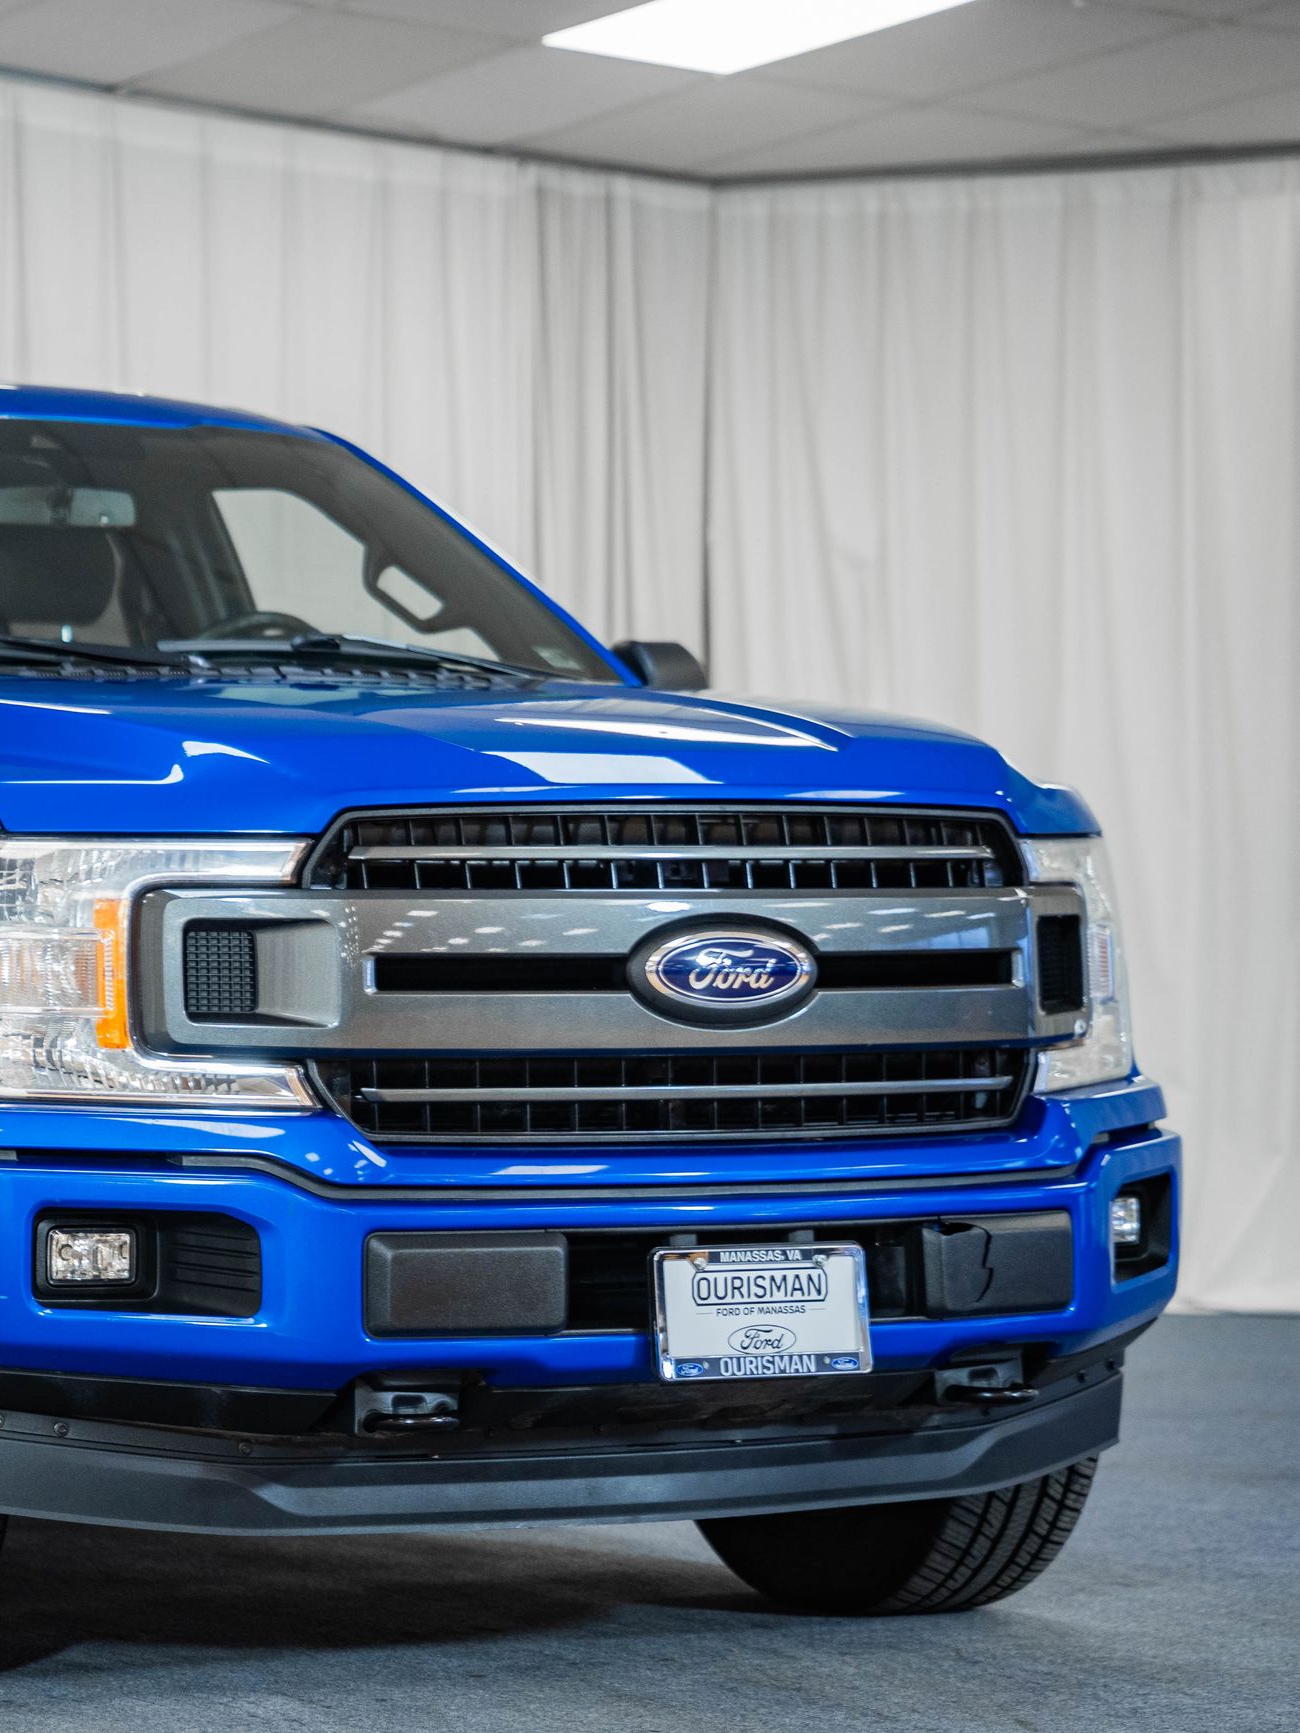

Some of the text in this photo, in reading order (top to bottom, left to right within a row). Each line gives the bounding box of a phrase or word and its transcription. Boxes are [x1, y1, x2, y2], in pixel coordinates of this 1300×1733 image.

[689, 947, 777, 990] Ford
[786, 1249, 802, 1262] VA
[696, 1273, 823, 1301] OURISMAN
[716, 1305, 806, 1317] FORD OF MANASSAS
[740, 1327, 784, 1351] Ford
[719, 1354, 816, 1377] OURISMAN
